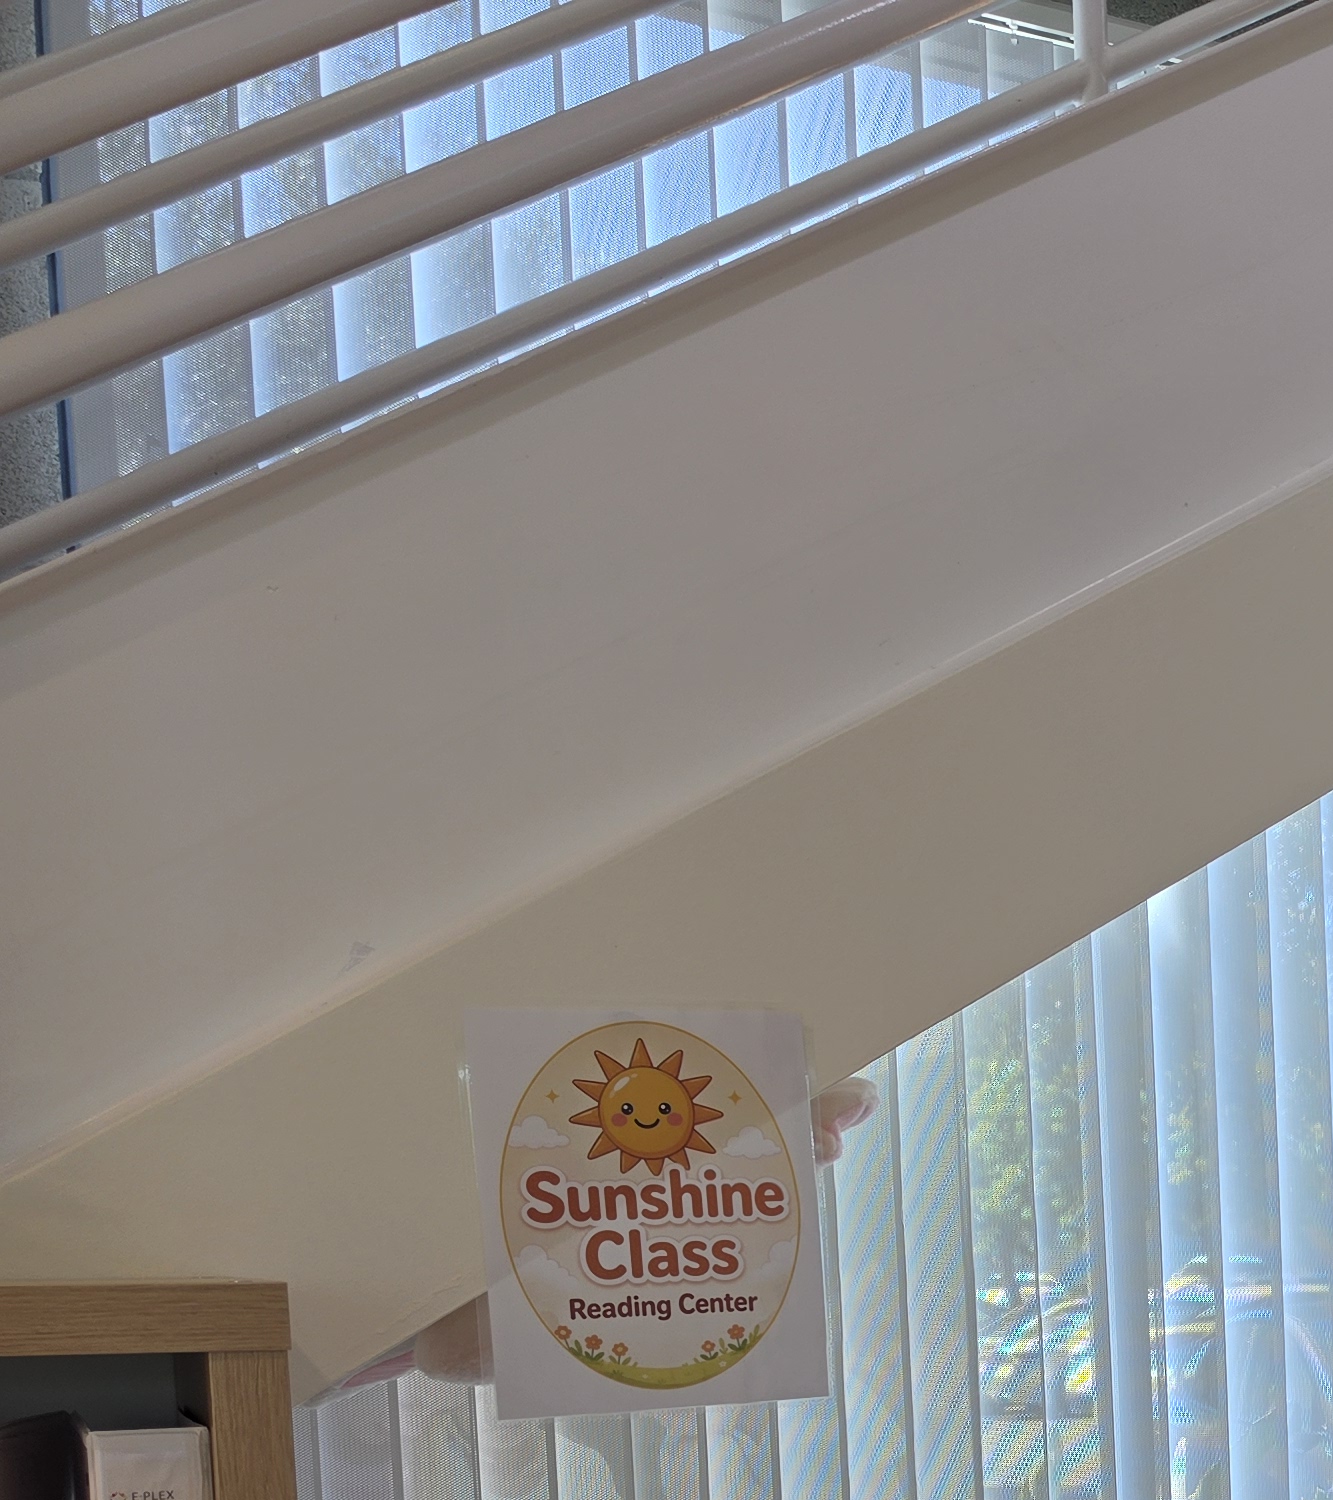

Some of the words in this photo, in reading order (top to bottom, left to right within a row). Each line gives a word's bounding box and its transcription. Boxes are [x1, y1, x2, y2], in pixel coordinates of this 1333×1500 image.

[525, 1168, 785, 1223] Sunshine
[585, 1228, 739, 1280] Class
[569, 1295, 672, 1321] Reading
[678, 1293, 758, 1315] Center
